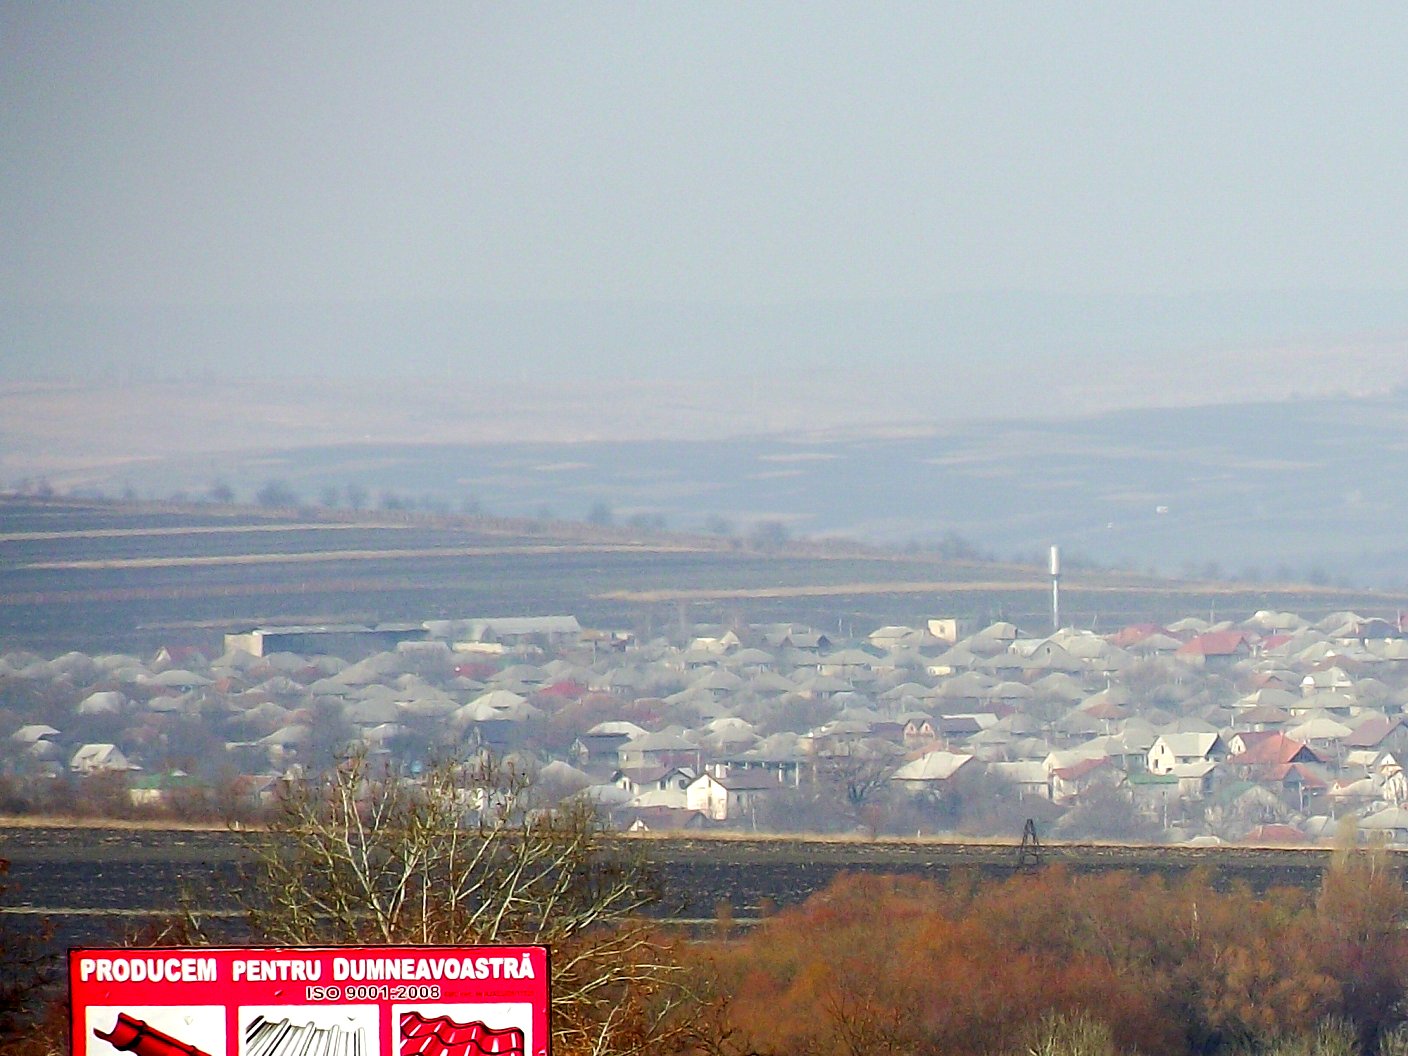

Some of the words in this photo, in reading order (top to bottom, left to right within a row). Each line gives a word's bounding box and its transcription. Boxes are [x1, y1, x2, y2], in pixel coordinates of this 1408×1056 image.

[80, 958, 217, 982] PRODUCEM
[232, 960, 321, 982] PENTRU
[333, 953, 535, 981] DUMNEAVOASTRĂ
[306, 986, 340, 1000] ISO
[346, 985, 441, 999] 9001:2008
